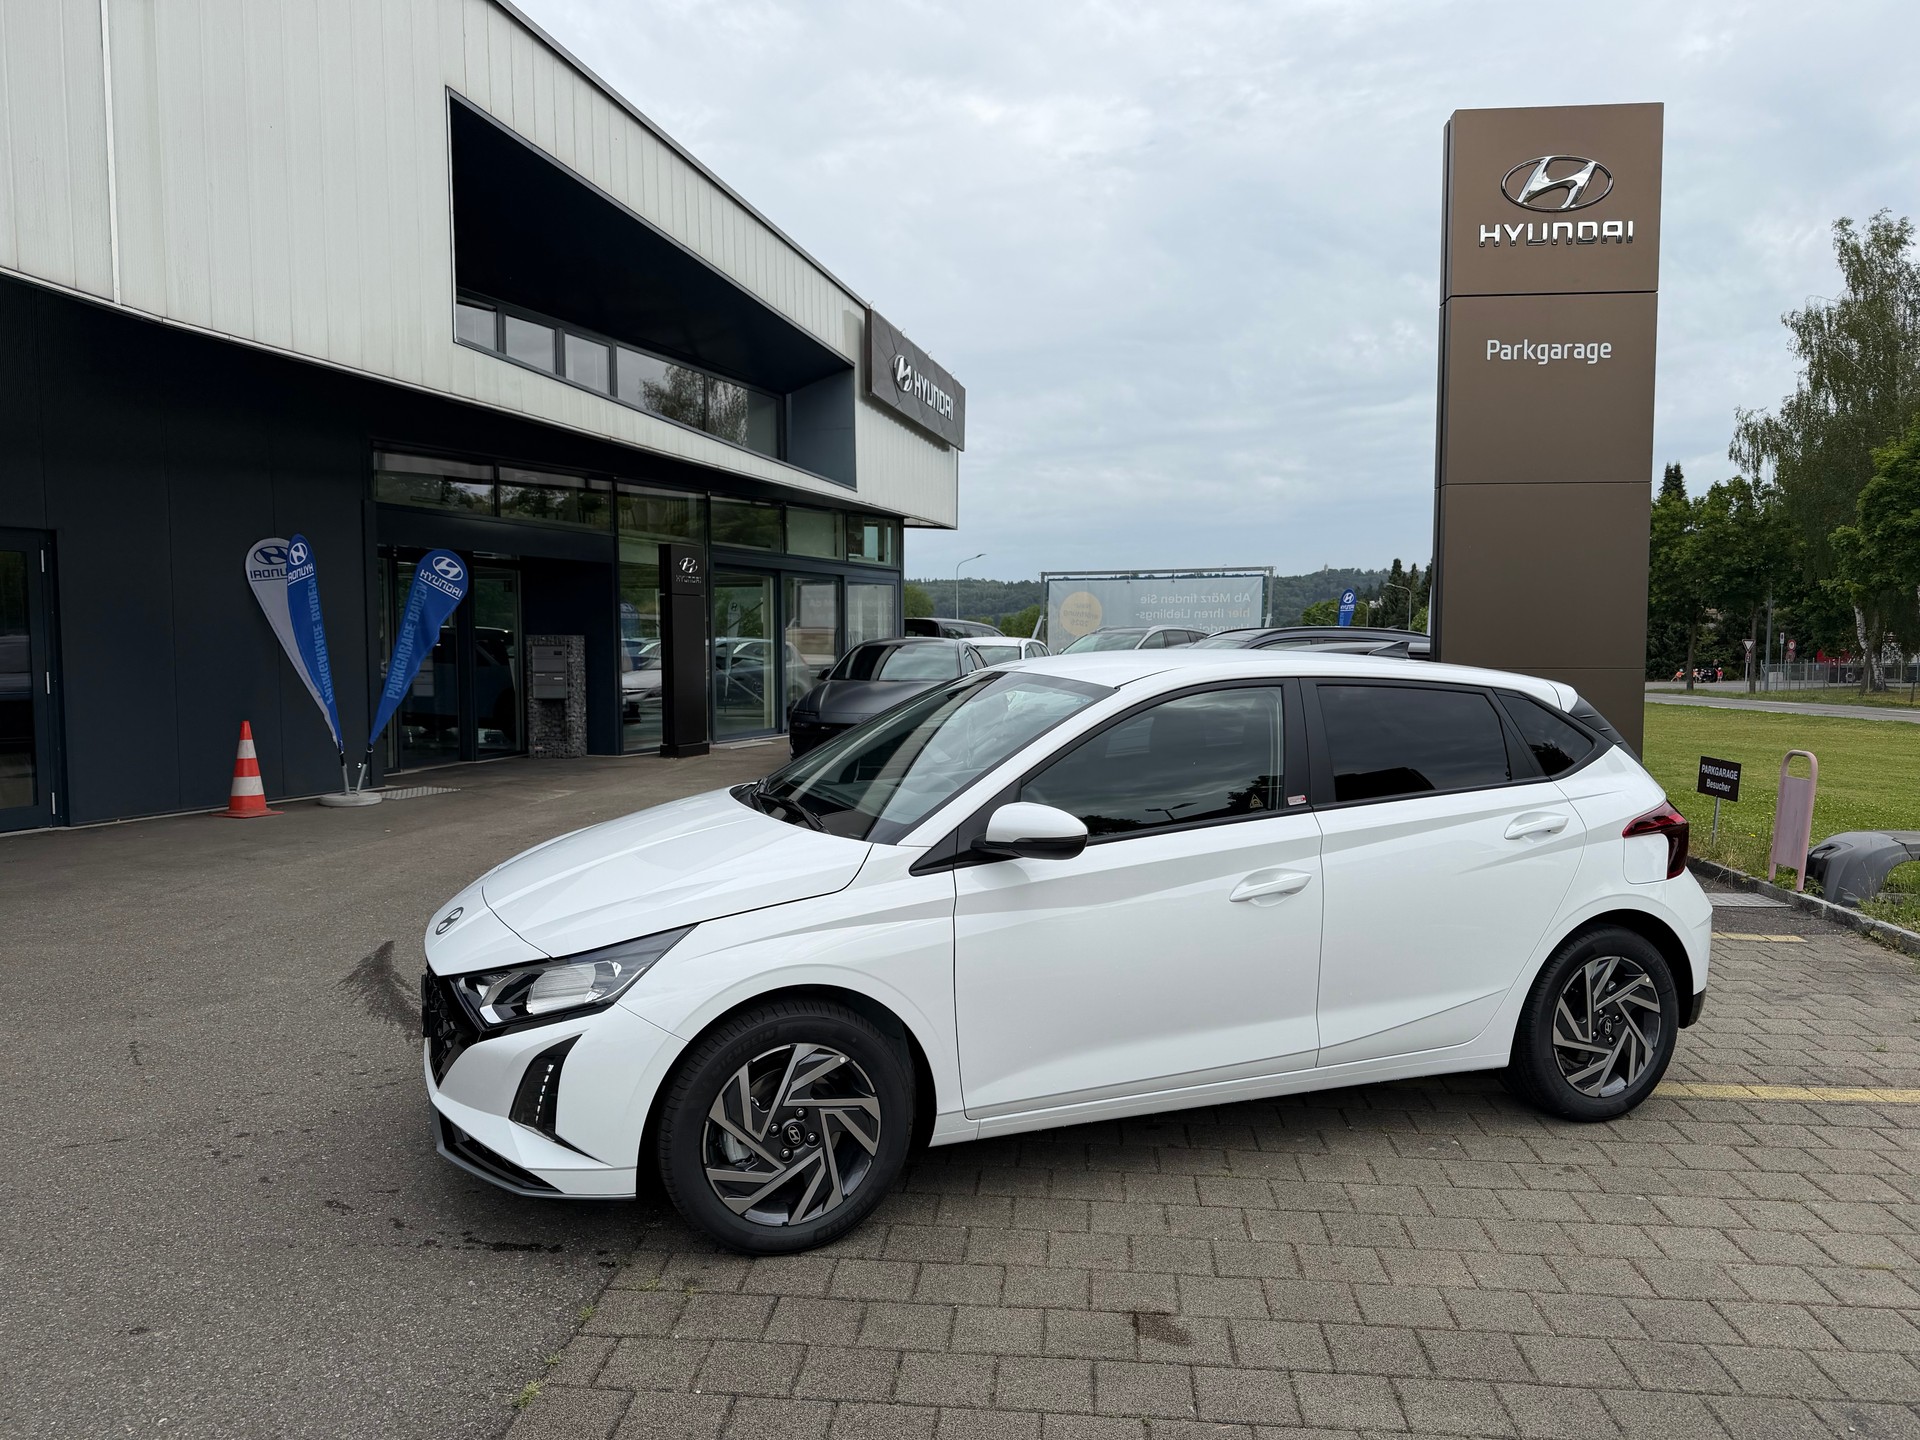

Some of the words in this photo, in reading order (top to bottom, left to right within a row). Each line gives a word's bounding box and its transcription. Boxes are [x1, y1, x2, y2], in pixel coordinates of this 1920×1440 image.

[1479, 220, 1634, 247] HYUNDAI
[1486, 339, 1612, 365] Parkgarage
[914, 370, 954, 421] HYUNDAI
[420, 569, 462, 598] HYUNDAI
[675, 574, 702, 584] HYUNDAI
[386, 622, 416, 699] PARKGARAGE
[407, 582, 428, 622] BADEN
[1701, 764, 1738, 780] PARKGARAGE
[1706, 779, 1731, 792] Besucher
